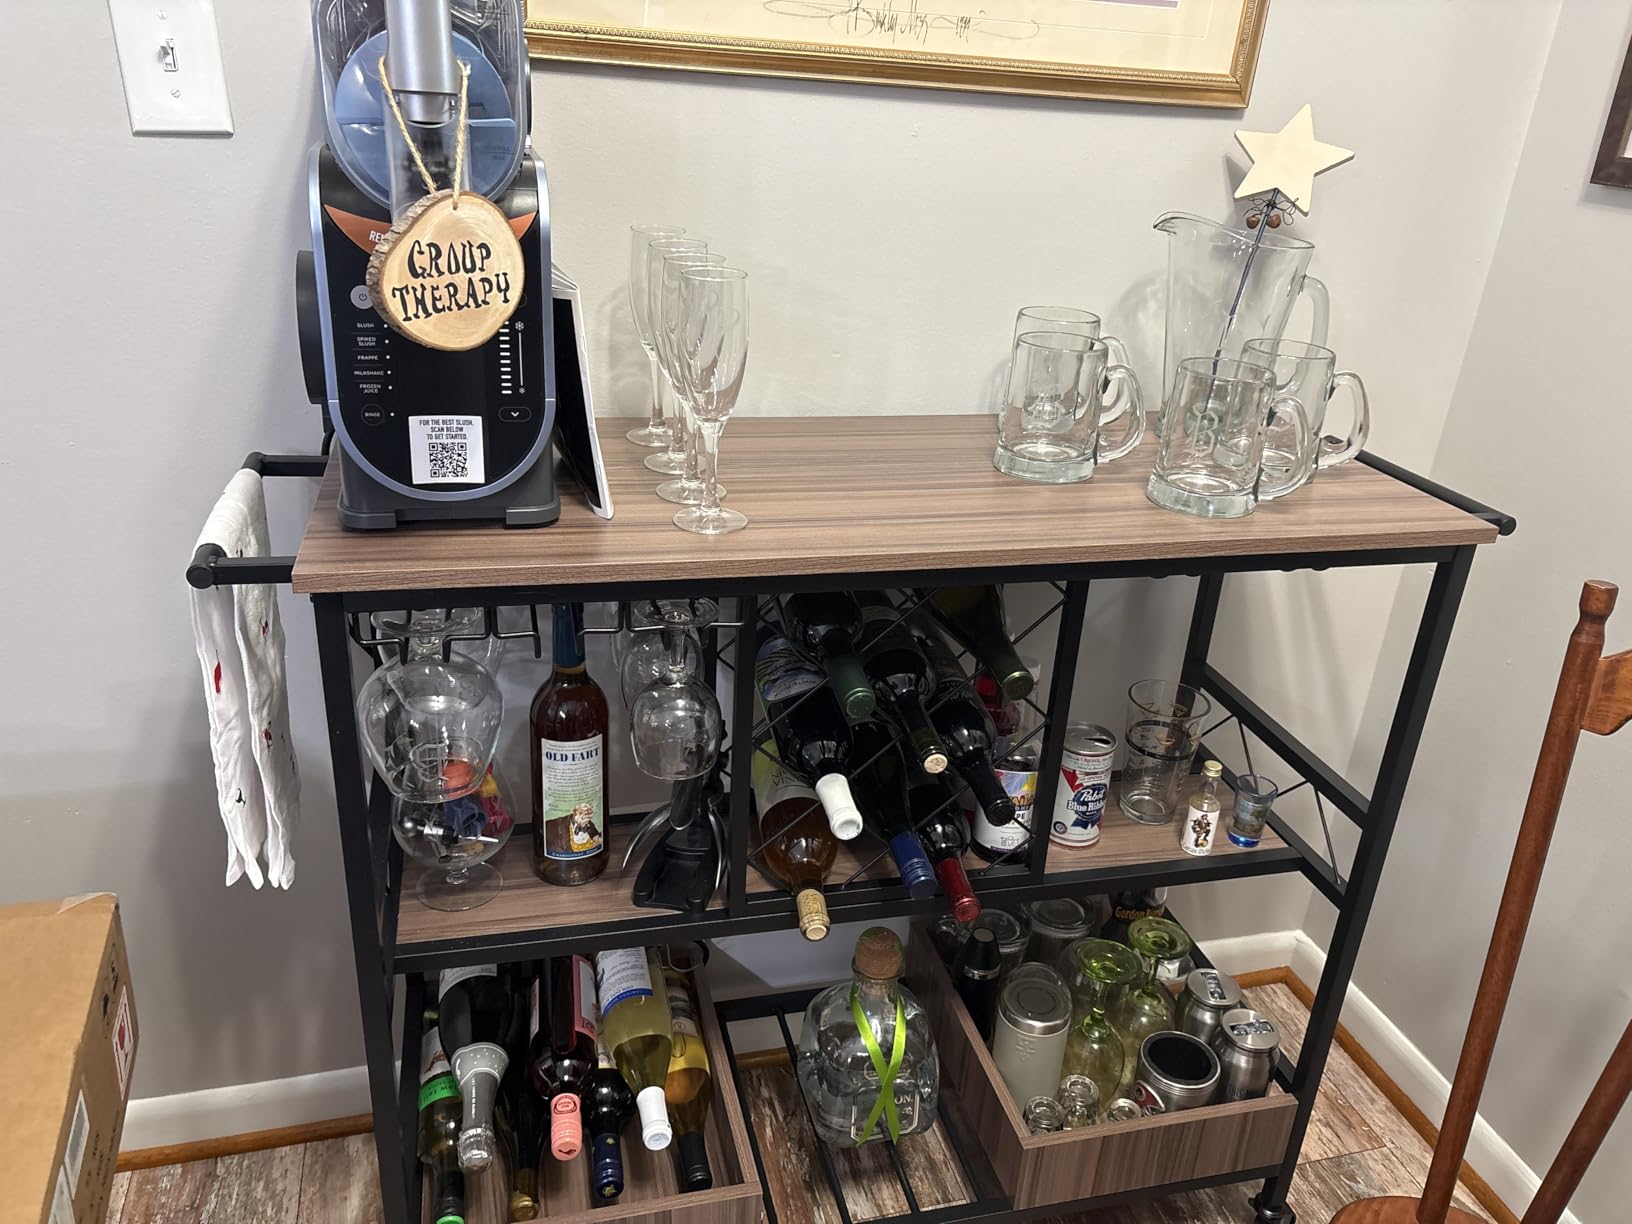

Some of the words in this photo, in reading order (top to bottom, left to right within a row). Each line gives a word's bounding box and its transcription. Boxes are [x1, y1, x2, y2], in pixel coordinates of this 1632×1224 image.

[407, 239, 492, 279] GROUP
[391, 272, 510, 322] THERAPY
[427, 433, 433, 441] TO
[545, 751, 568, 762] OLD
[571, 747, 600, 762] FART
[1080, 788, 1106, 802] Pabst
[1066, 799, 1088, 812] Blue
[1114, 905, 1146, 920] Gordon
